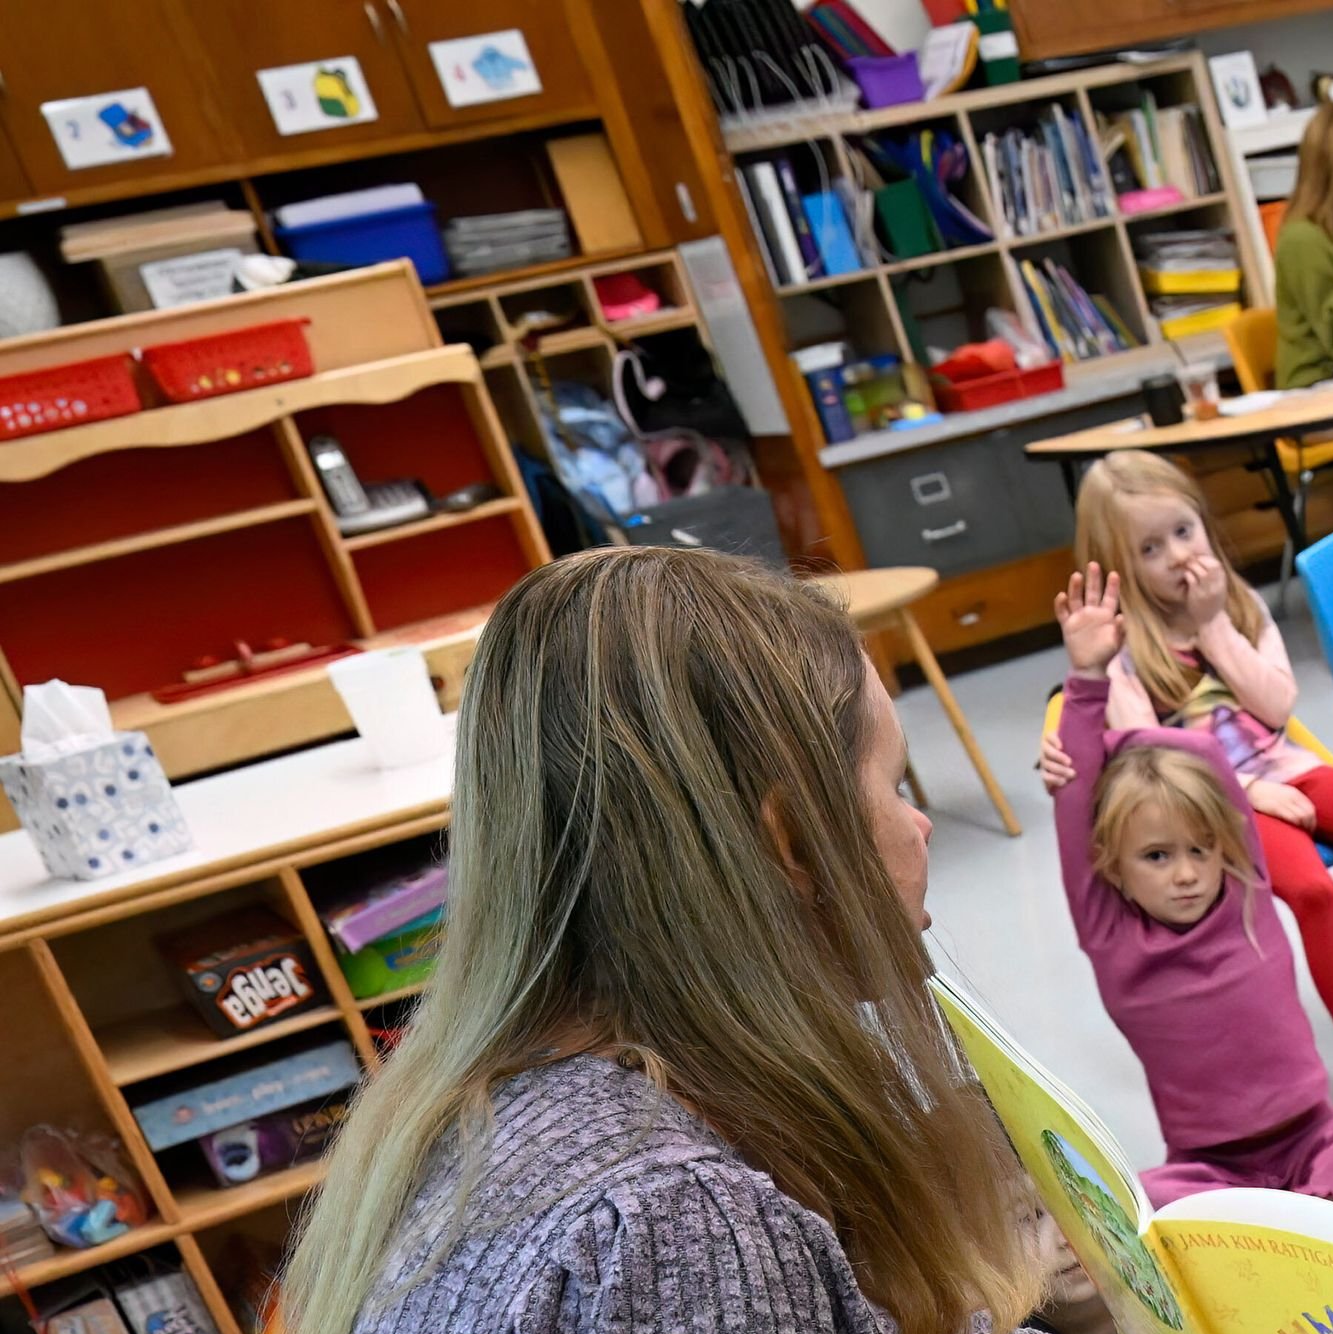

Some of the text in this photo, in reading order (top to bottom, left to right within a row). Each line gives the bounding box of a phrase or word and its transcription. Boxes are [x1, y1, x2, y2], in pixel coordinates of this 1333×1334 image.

[223, 957, 310, 1026] Jenga
[1179, 1233, 1228, 1250] JAMA
[1233, 1234, 1265, 1251] KIM
